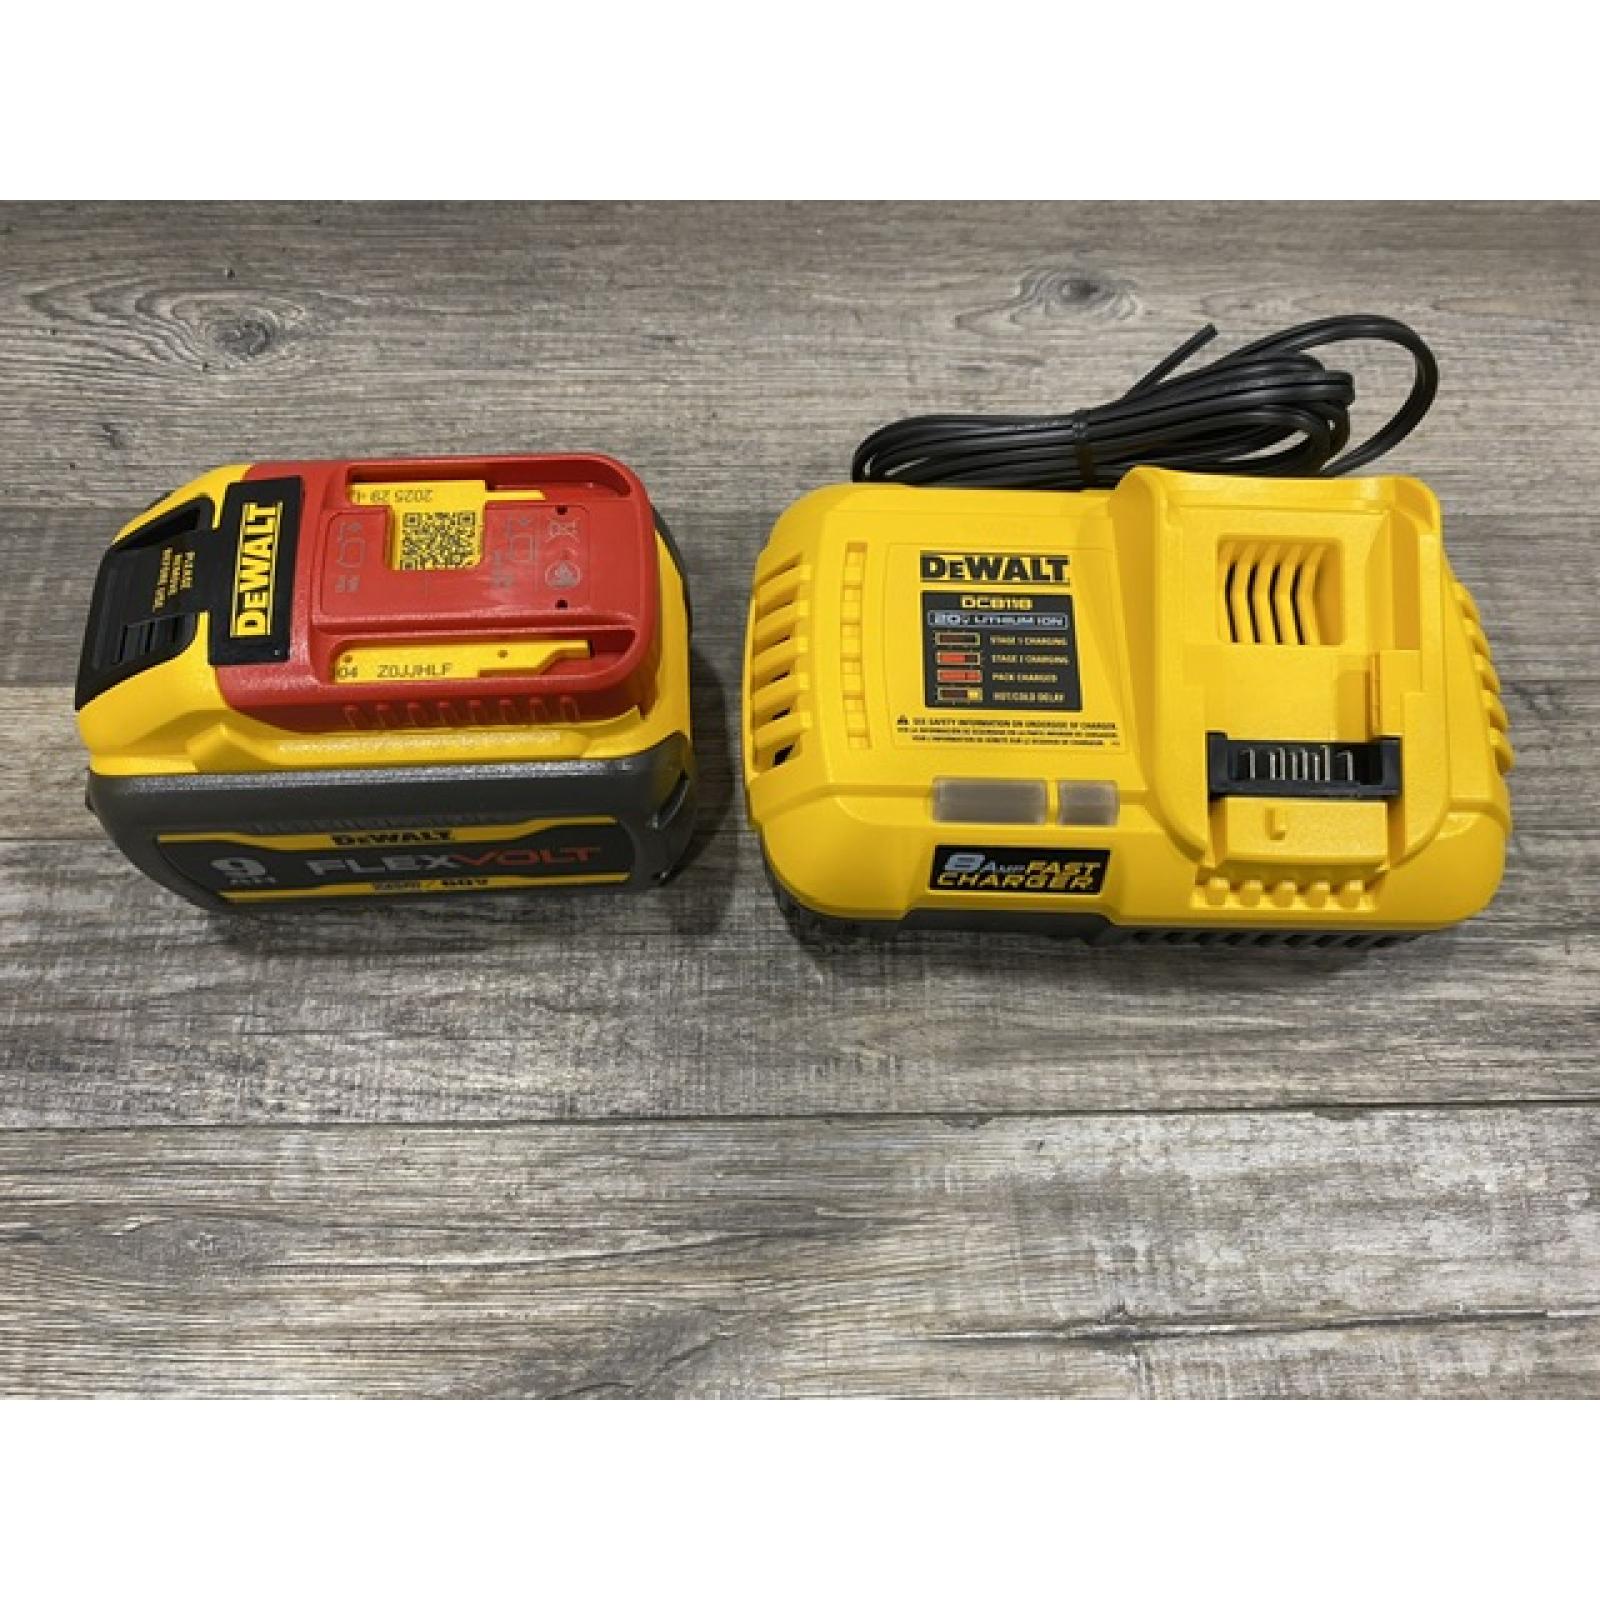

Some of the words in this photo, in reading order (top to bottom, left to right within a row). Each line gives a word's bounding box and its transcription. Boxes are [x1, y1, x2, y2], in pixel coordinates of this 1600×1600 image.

[235, 502, 280, 636] DEWALT
[920, 554, 1069, 583] DEWALT
[1036, 615, 1065, 628] ION
[304, 846, 601, 877] FLEXVOLT
[937, 872, 1094, 890] CHARGER
